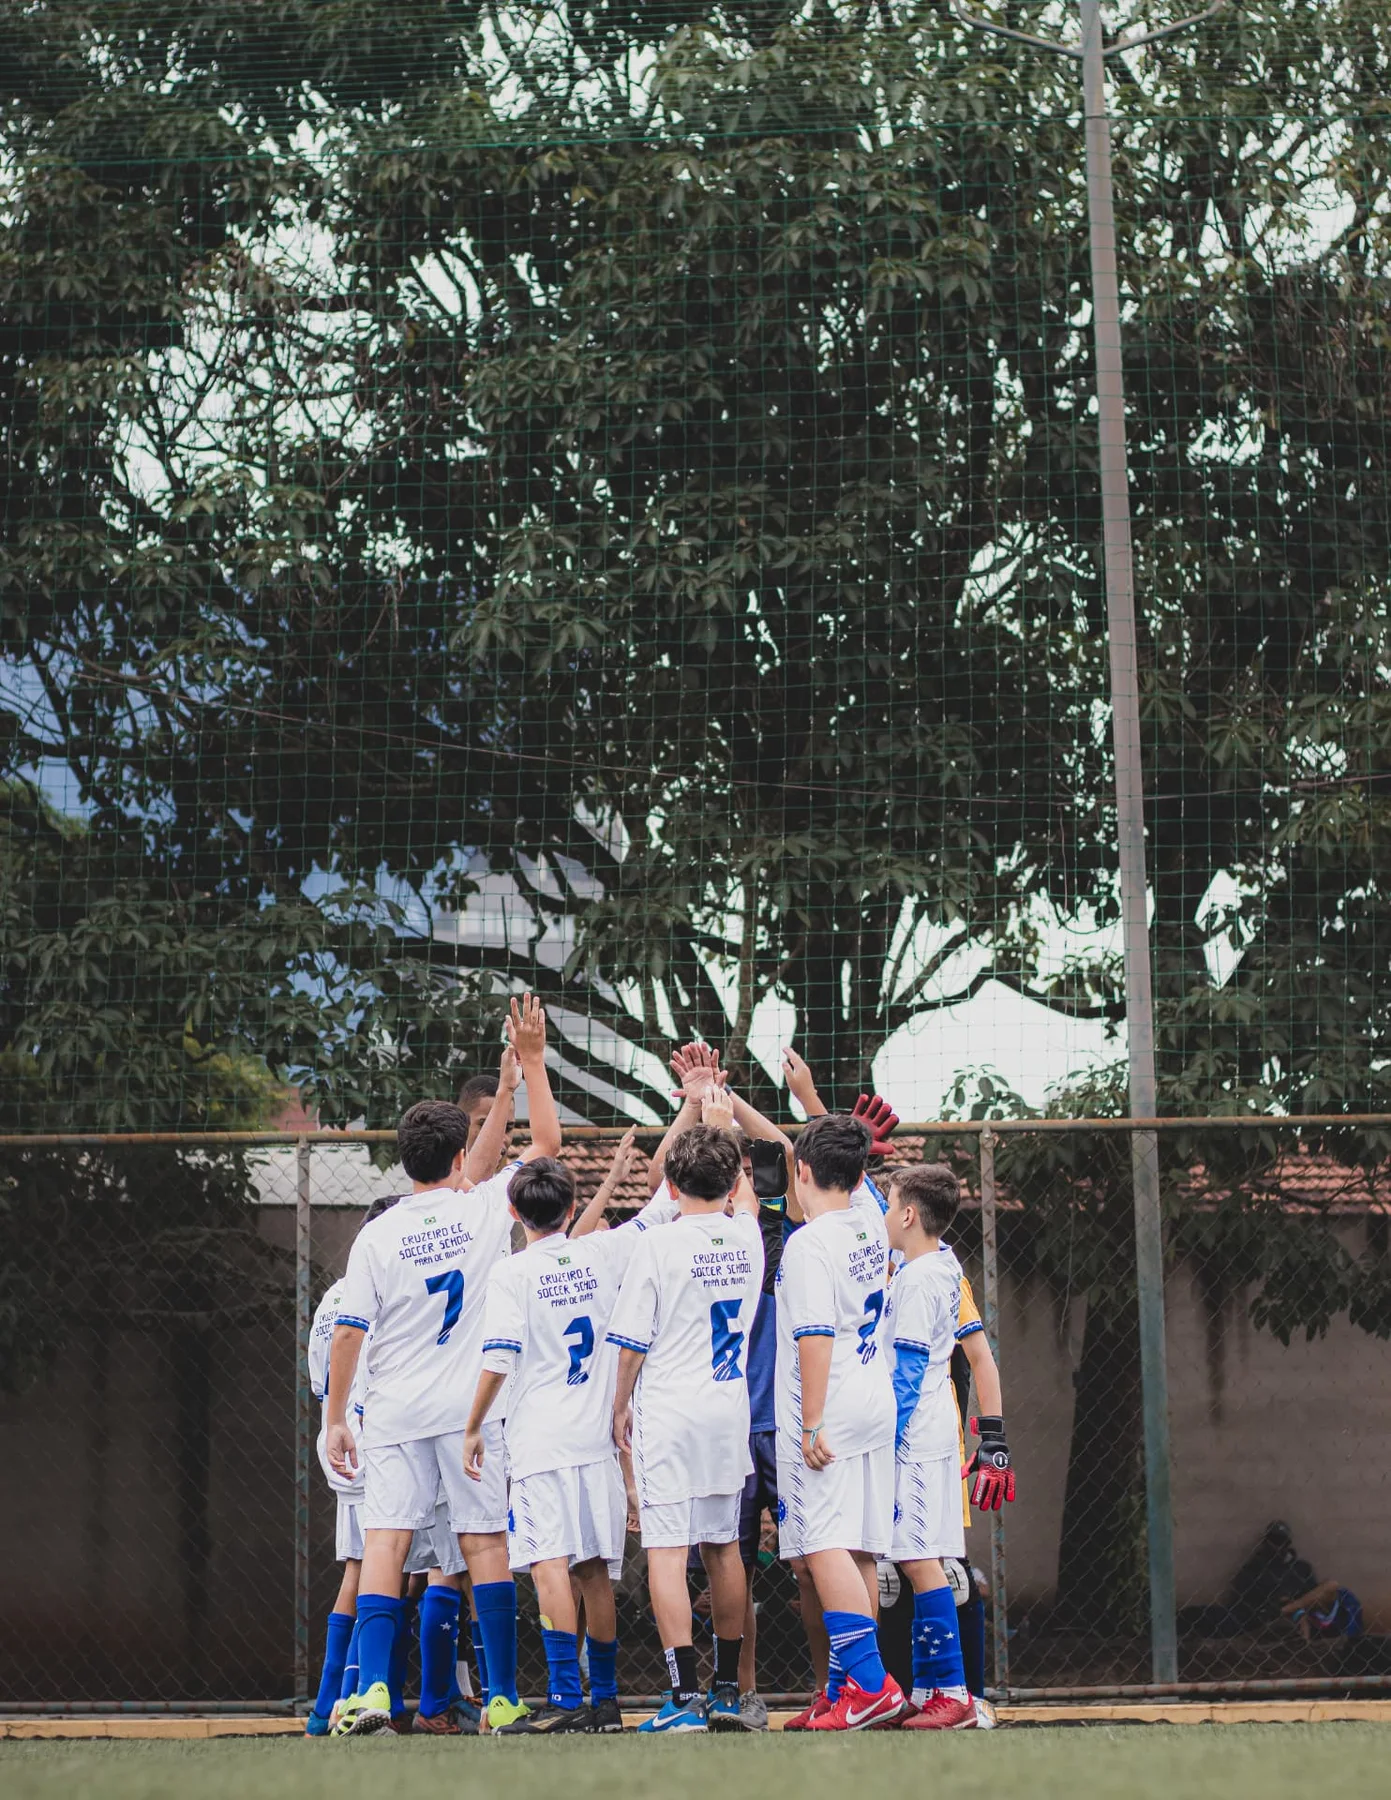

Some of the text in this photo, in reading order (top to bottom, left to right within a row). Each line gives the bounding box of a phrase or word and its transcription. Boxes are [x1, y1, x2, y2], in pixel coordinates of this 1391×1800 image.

[401, 1227, 449, 1246] CRUZEIRO
[398, 1232, 475, 1260] SOCCER SCHOOL
[434, 1253, 444, 1262] DE
[693, 1251, 735, 1265] CRUZEIRO
[539, 1268, 583, 1286] CRUZEIRO
[690, 1262, 752, 1279] SOCCER SCHOOL
[536, 1284, 571, 1300] SOCCER
[425, 1269, 465, 1345] 7
[710, 1298, 744, 1381] 6
[562, 1315, 595, 1386] 2
